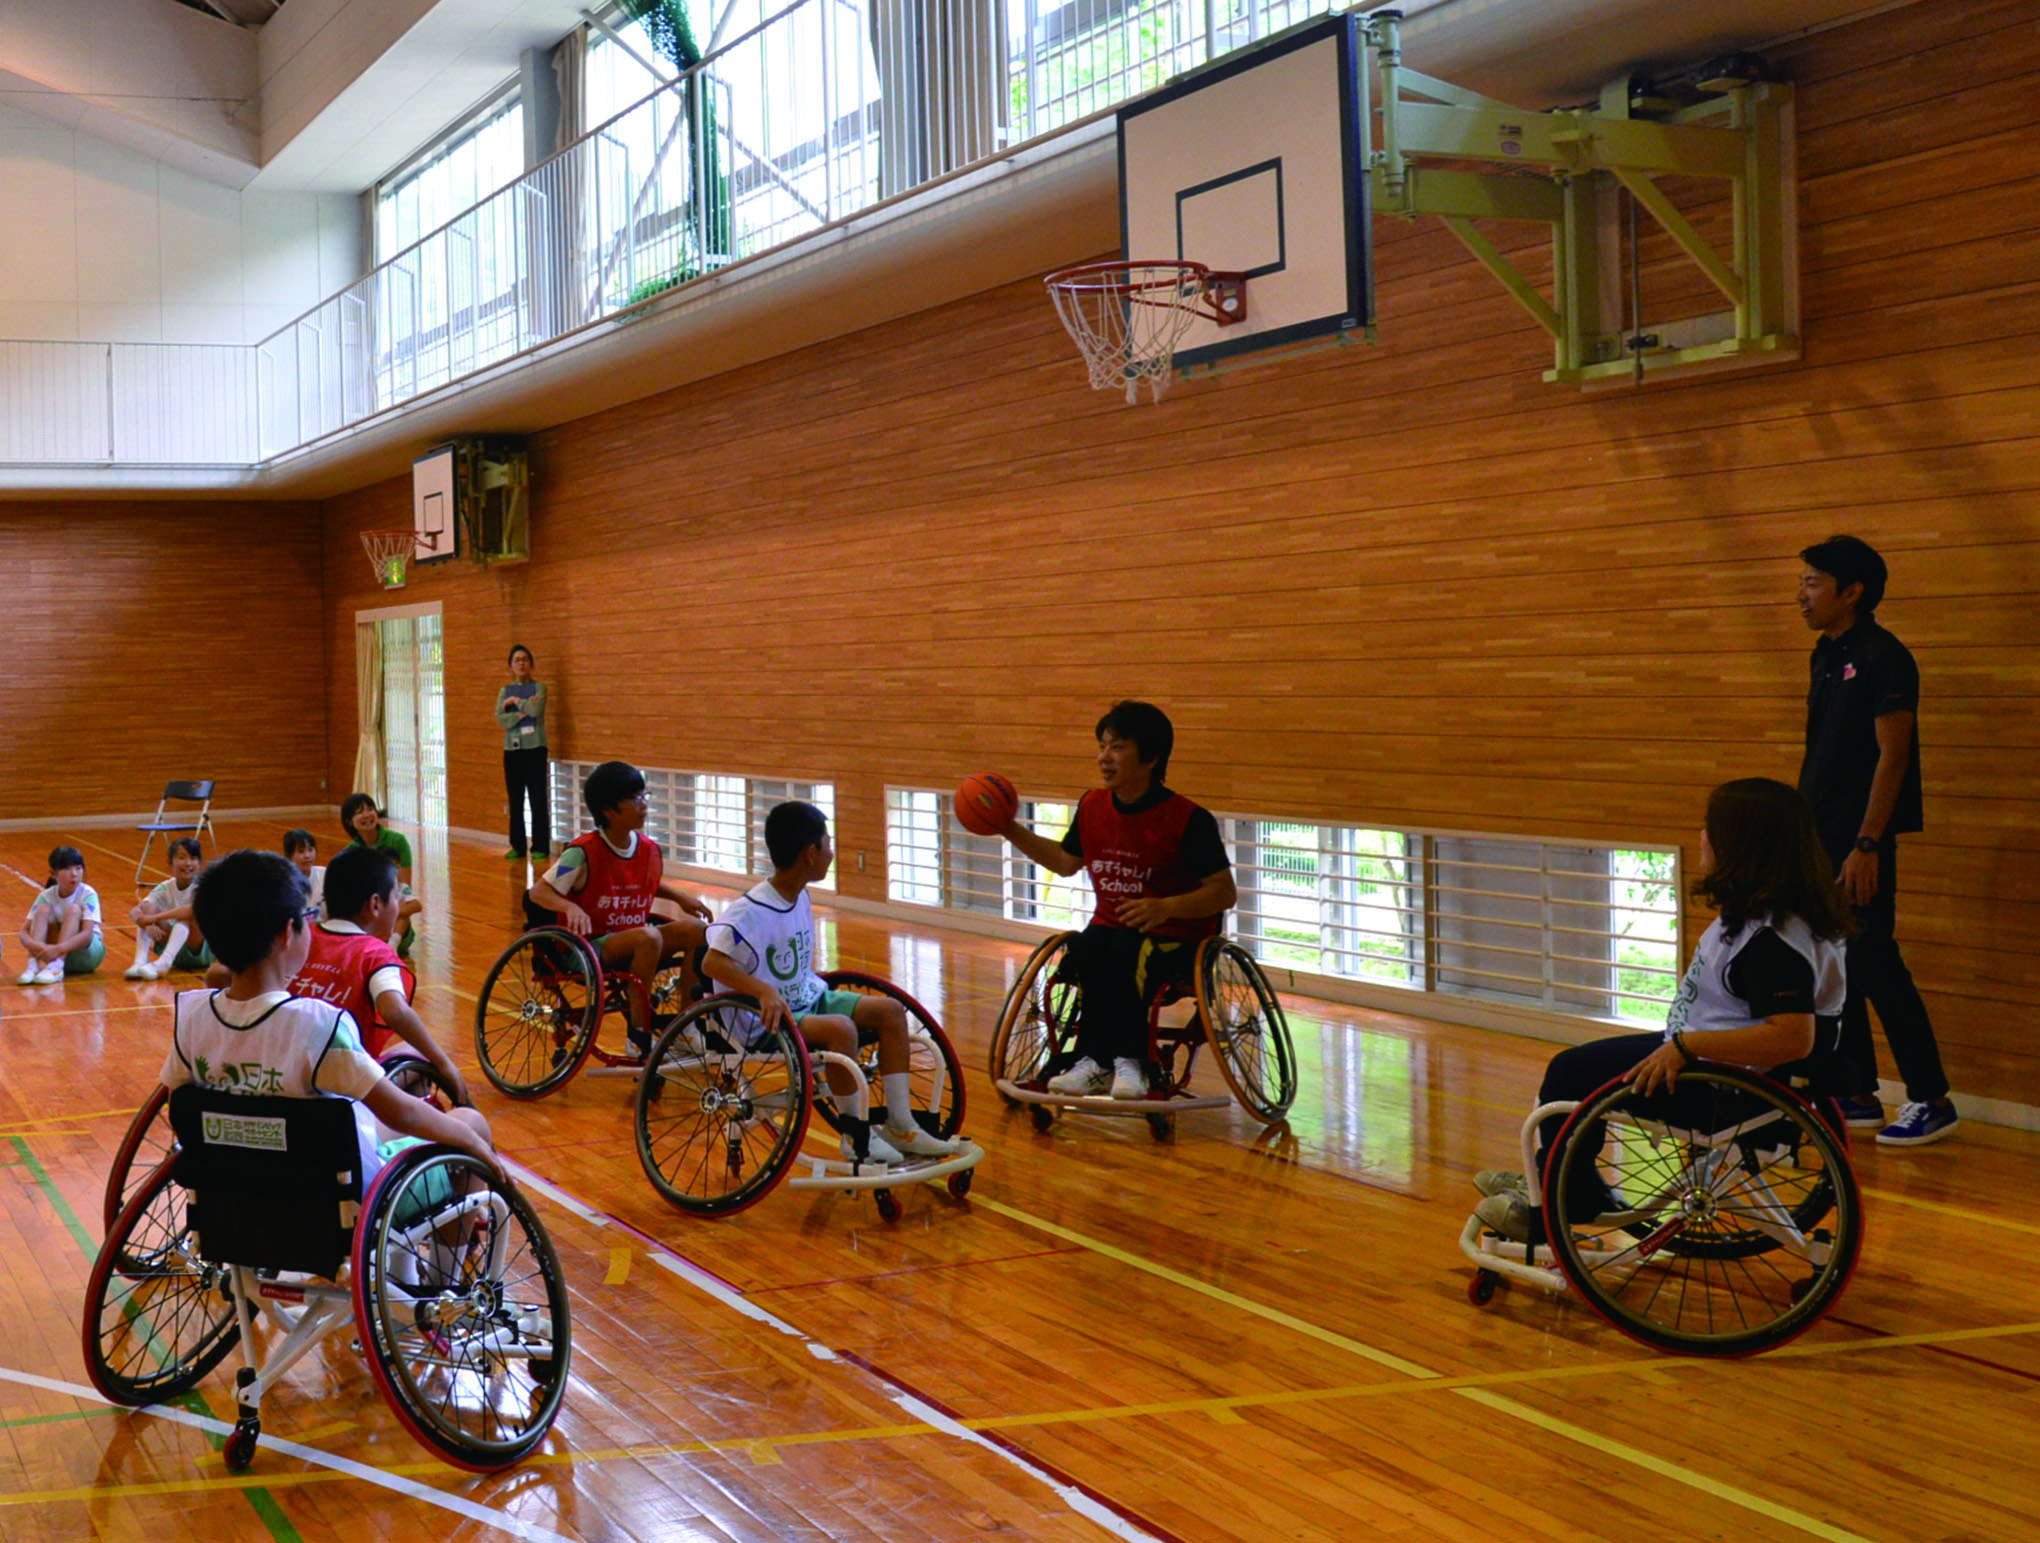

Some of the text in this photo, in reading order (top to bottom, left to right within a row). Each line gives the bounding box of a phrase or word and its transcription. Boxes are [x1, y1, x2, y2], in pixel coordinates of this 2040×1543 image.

[1099, 877, 1143, 893] School
[606, 911, 646, 926] School
[241, 1063, 285, 1093] 日本
